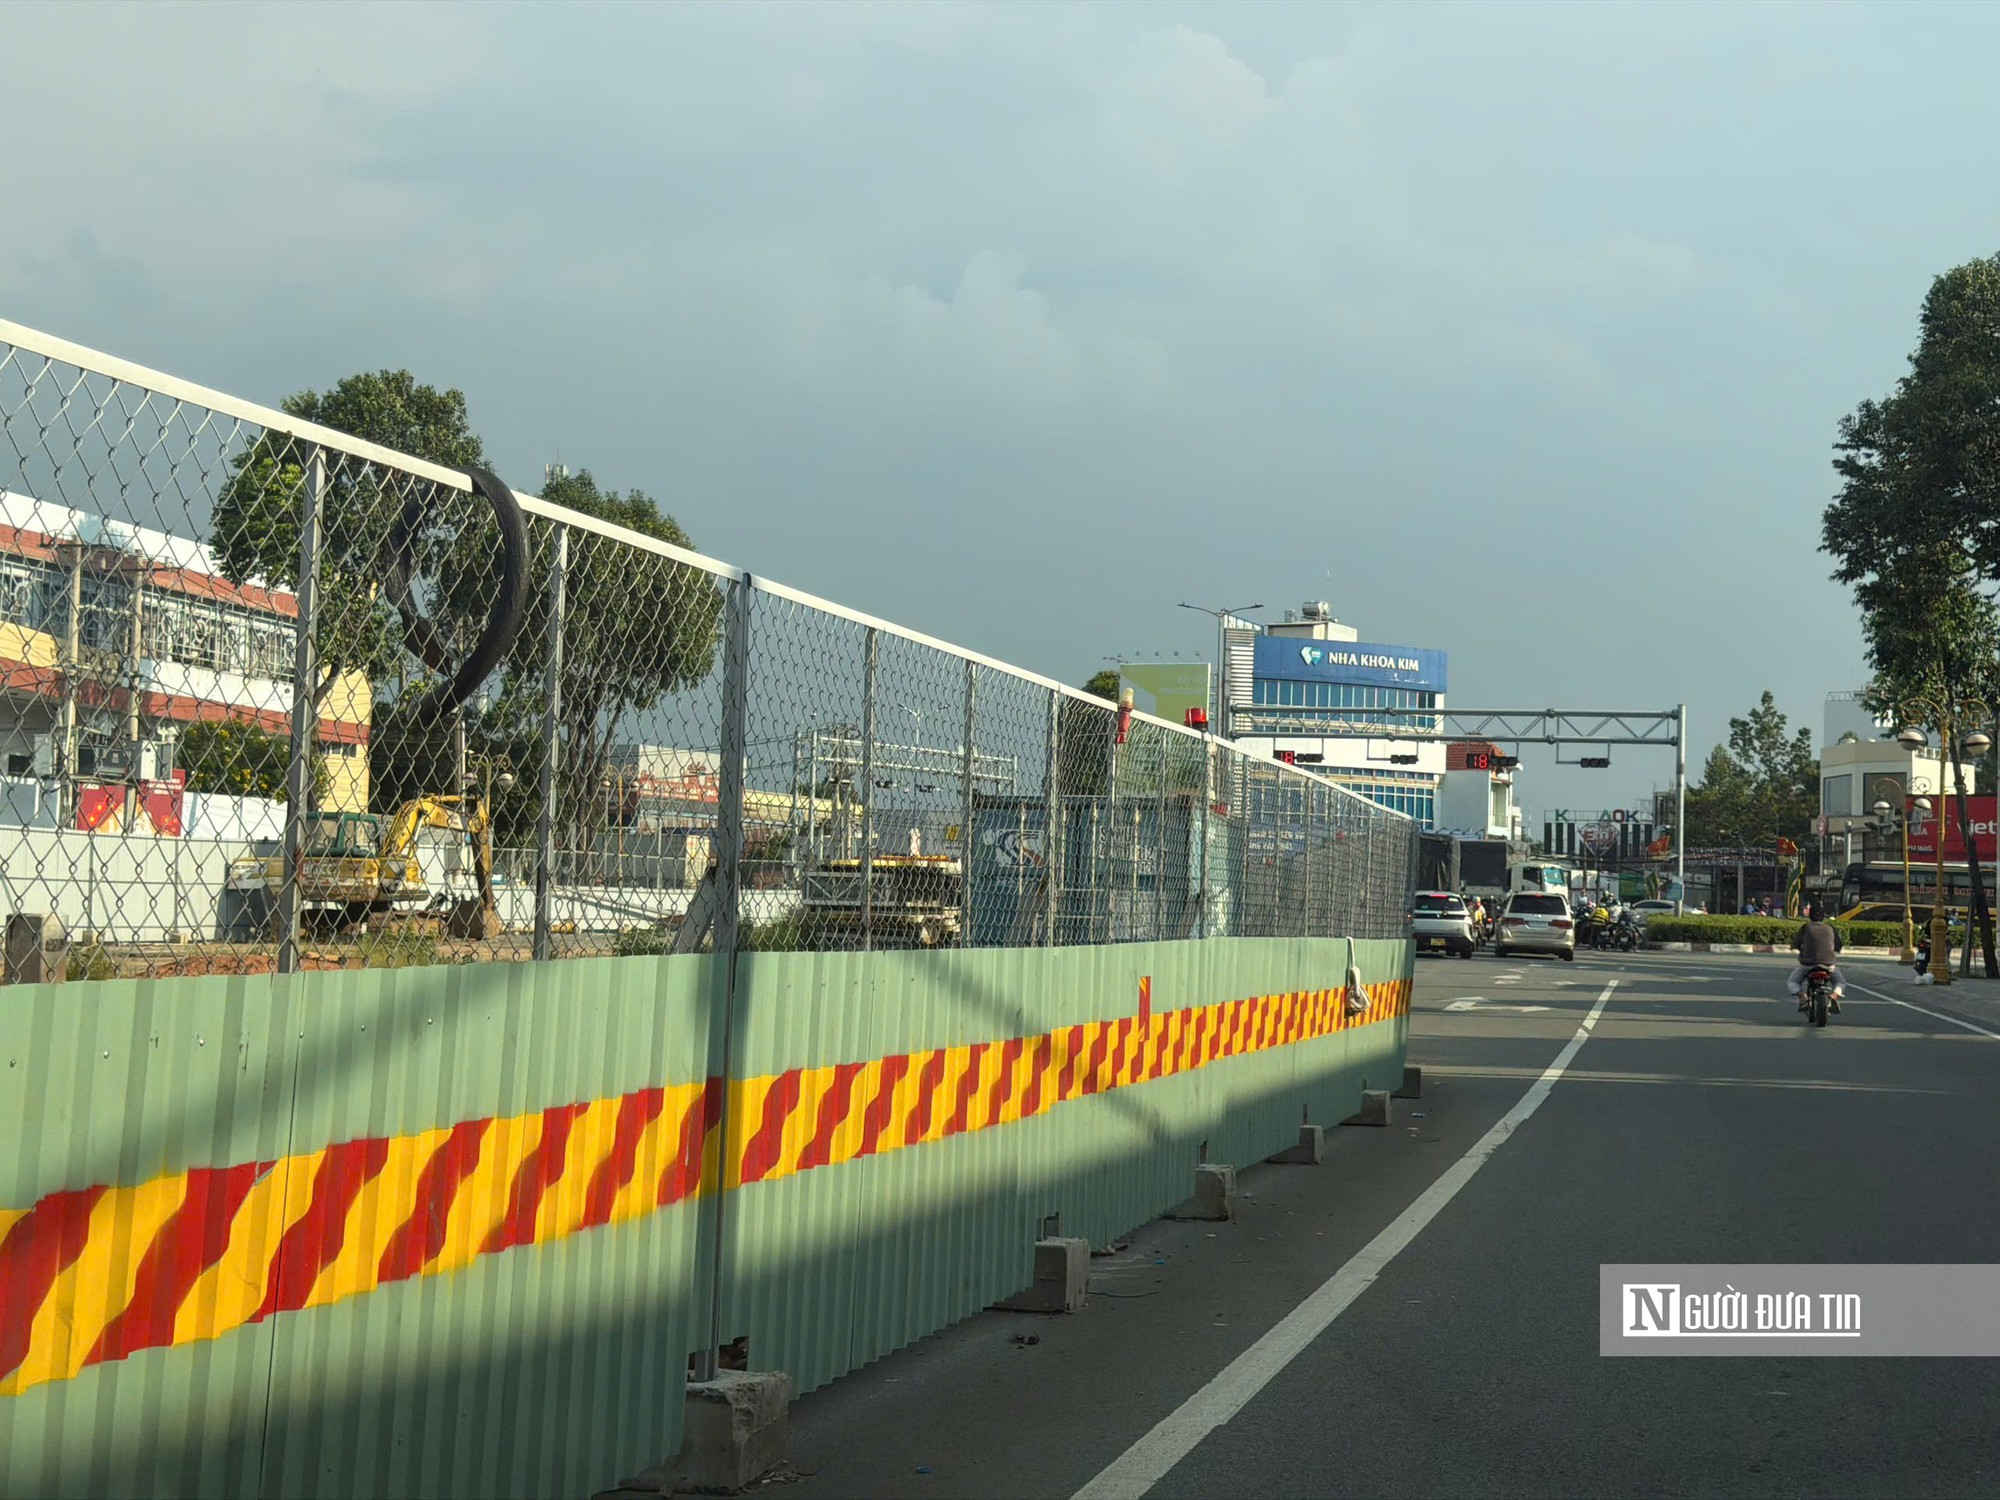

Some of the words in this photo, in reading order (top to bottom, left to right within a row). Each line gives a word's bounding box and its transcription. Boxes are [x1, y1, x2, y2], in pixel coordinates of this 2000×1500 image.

[1328, 652, 1358, 666] NHA
[1360, 654, 1396, 669] KHOA
[1398, 657, 1419, 671] KIM
[1473, 755, 1488, 769] 18
